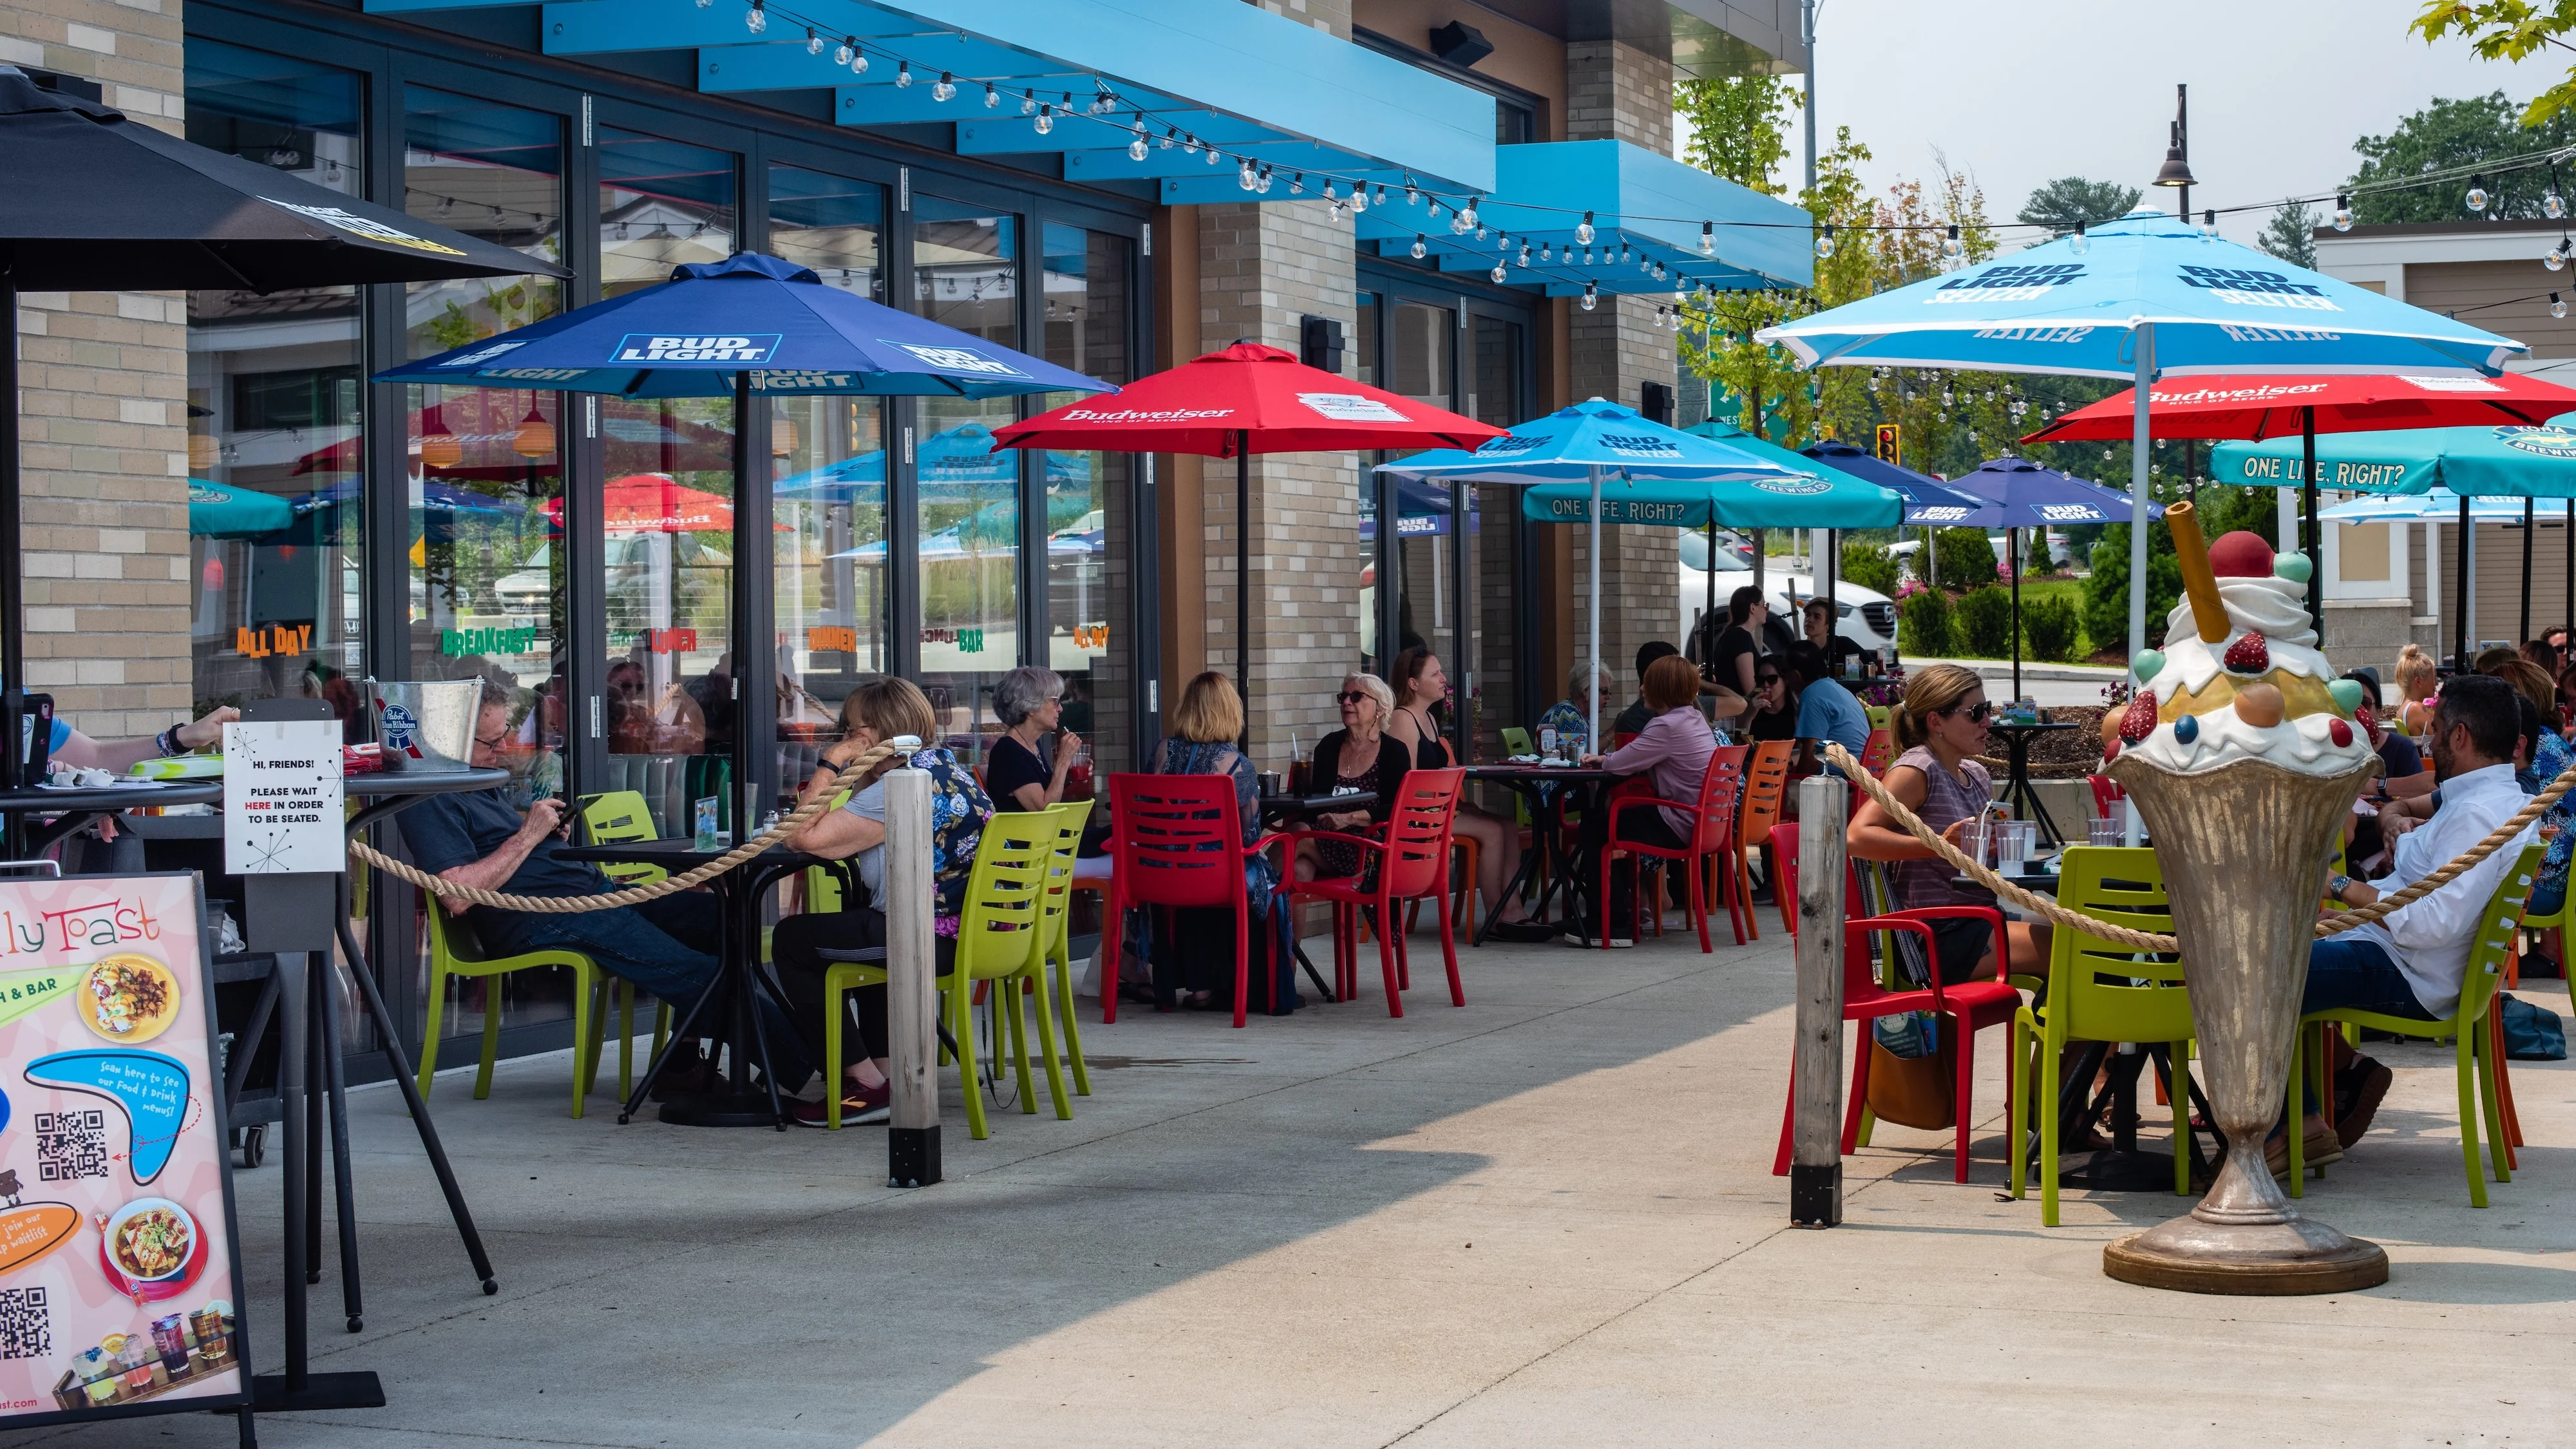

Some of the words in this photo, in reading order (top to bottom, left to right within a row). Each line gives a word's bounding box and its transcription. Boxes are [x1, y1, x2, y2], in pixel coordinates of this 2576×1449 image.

[1978, 264, 2086, 278] BUD
[2179, 265, 2288, 283] BUD
[1937, 273, 2088, 290] LIGHT
[2177, 275, 2325, 297] LIGHT
[1923, 286, 2053, 304] SELTZER
[2209, 289, 2345, 312] SELTZER
[647, 337, 750, 350] BUD
[620, 348, 765, 361] LIGHT
[900, 345, 979, 361] BUD
[914, 354, 1018, 375] LIGHT
[1060, 408, 1235, 421] Budweiser
[1597, 439, 1678, 451] LIGHT
[1601, 433, 1661, 444] BUD
[1612, 447, 1685, 459] SELTZER
[2244, 457, 2281, 478] ONE
[2287, 459, 2331, 484] LIE,
[2337, 462, 2406, 486] RIGHT?
[1759, 483, 1817, 493] BREWING
[1552, 498, 1582, 515] ONE
[1629, 502, 1685, 521] RIGHT?
[2041, 511, 2100, 520] LIGHT
[2043, 505, 2087, 513] BUD
[1910, 512, 1968, 521] LIGHT
[236, 627, 270, 659] ALL
[274, 625, 312, 657] DAY
[442, 627, 536, 658] BREAKFAST
[651, 627, 697, 655] LUNCH
[808, 625, 857, 653] DINNER
[959, 629, 984, 653] BAR
[1074, 626, 1090, 649] ALL
[1092, 626, 1110, 648] DAY
[386, 709, 405, 720] Pabst
[381, 721, 393, 729] Blue
[393, 721, 416, 729] Ribbon
[253, 761, 266, 770] HI,
[269, 760, 314, 768] FRIENDS!
[251, 788, 289, 796] PLEASE
[292, 787, 317, 795] WAIT
[274, 801, 285, 810] IN
[289, 800, 323, 809] ORDER
[266, 815, 278, 823] BE
[281, 814, 321, 823] SEATED.
[12, 988, 23, 999] &
[26, 978, 57, 996] BAR
[125, 1065, 146, 1080] here
[150, 1073, 160, 1083] to
[99, 1077, 114, 1086] our
[26, 1213, 41, 1224] our
[10, 1226, 48, 1248] waitlist
